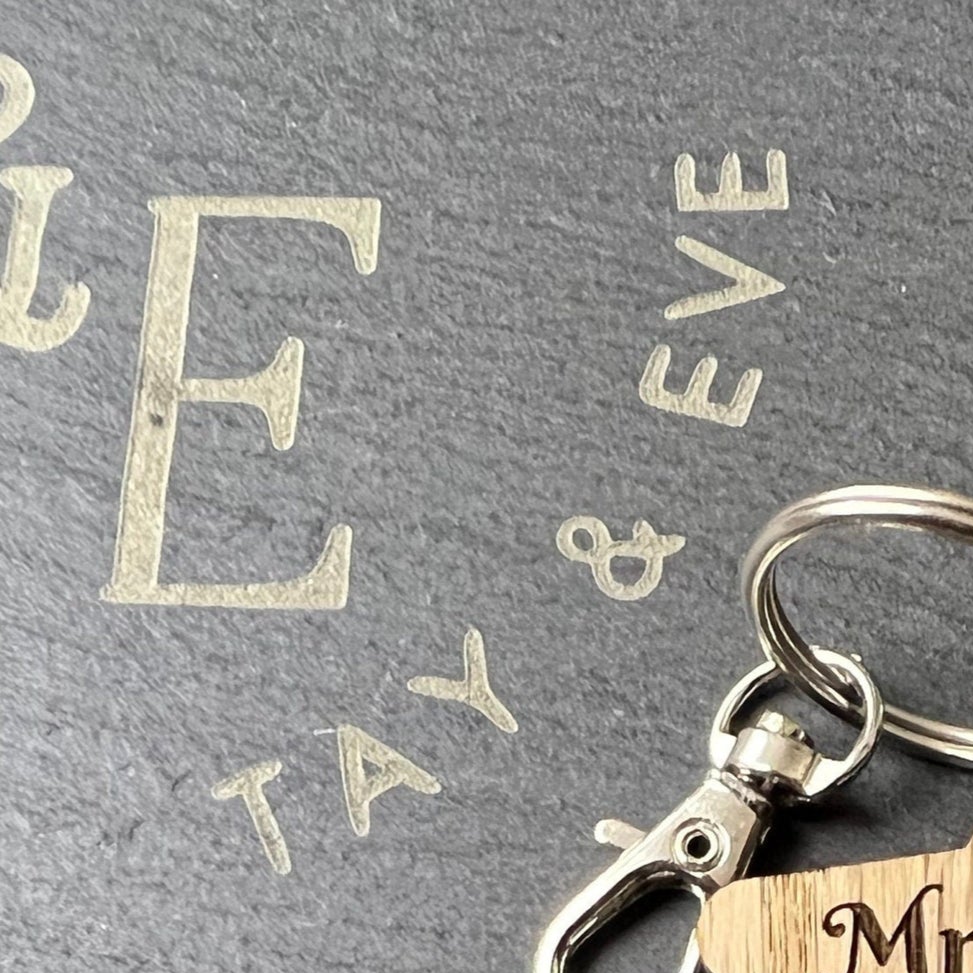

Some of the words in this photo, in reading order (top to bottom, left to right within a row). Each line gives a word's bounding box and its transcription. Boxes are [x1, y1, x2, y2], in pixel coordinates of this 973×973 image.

[99, 196, 381, 610] E
[211, 628, 518, 875] TAY
[556, 515, 686, 601] &
[639, 148, 789, 427] EVE
